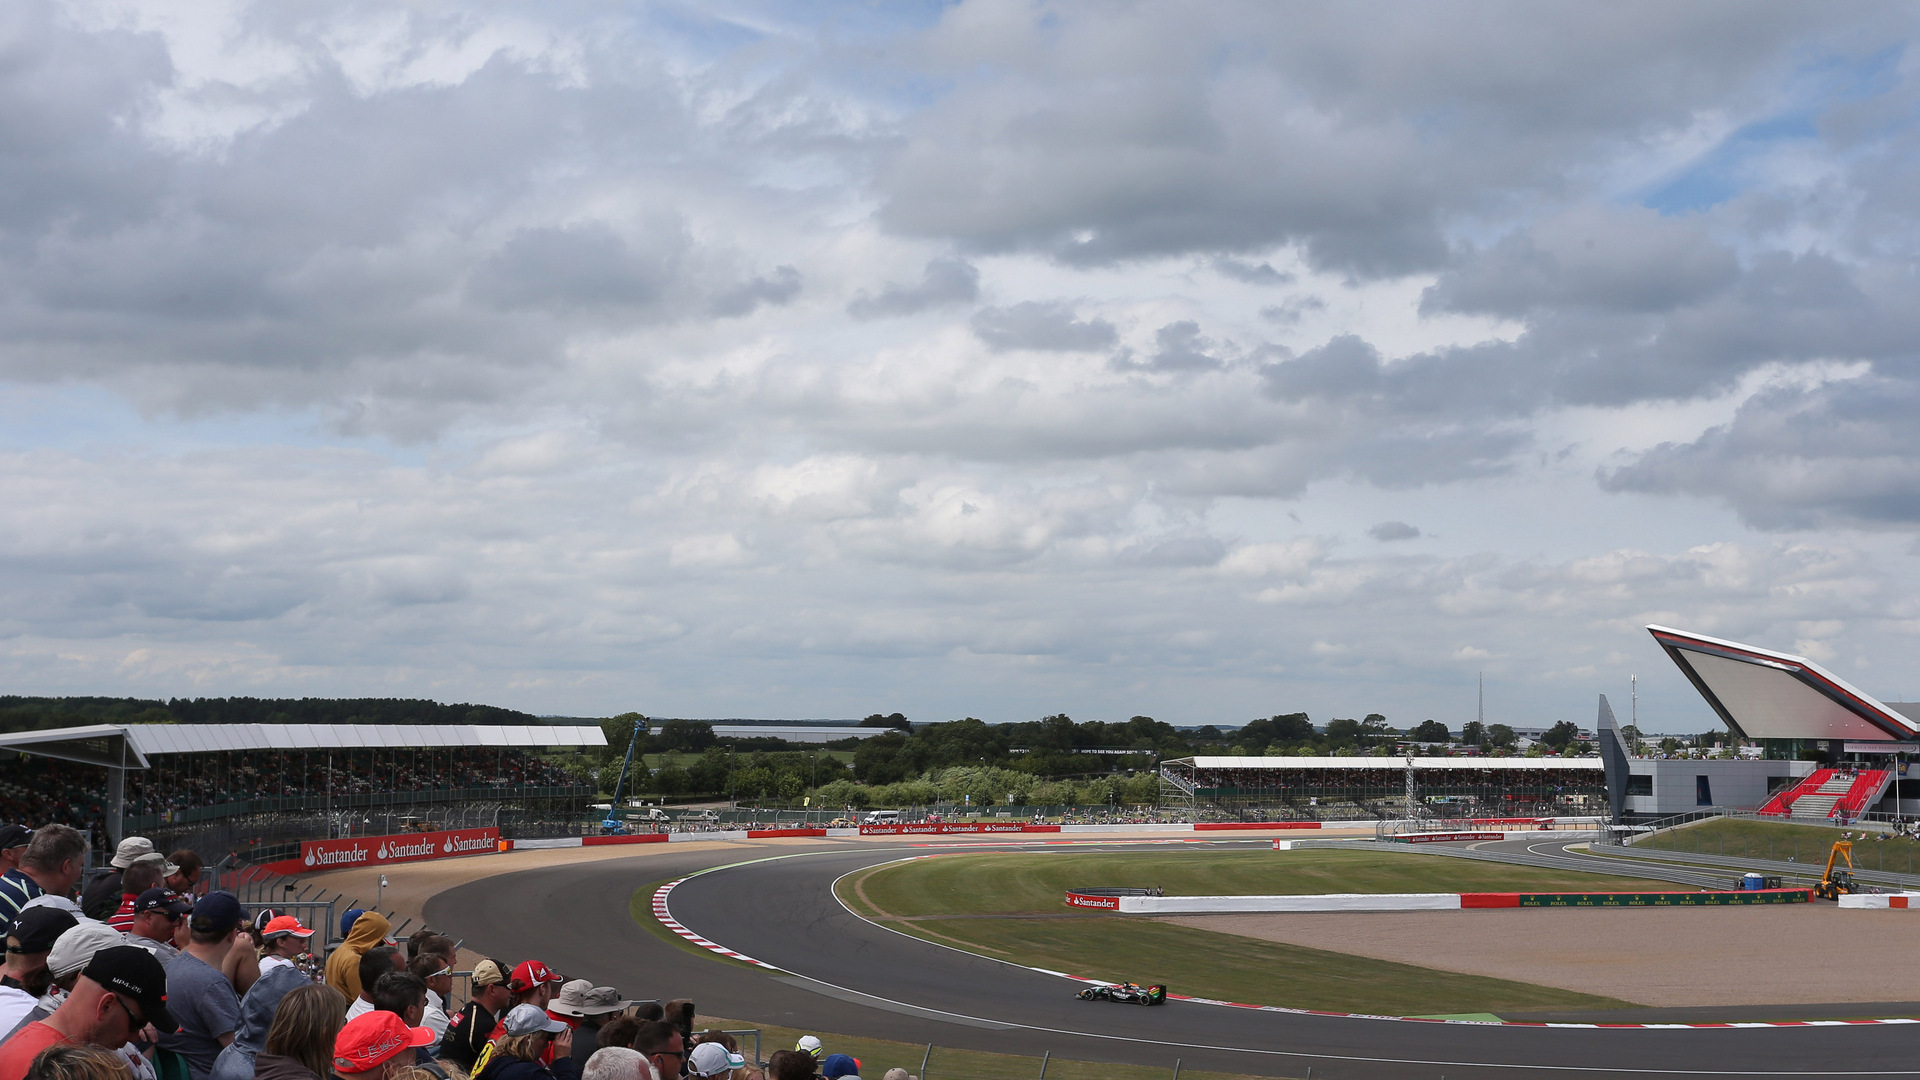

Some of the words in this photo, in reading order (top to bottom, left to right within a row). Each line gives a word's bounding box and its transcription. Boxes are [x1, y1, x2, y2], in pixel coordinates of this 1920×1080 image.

[869, 826, 897, 834] Santander
[908, 825, 937, 833] Santander
[992, 824, 1022, 832] Santander
[388, 837, 435, 858] Santander
[452, 832, 495, 852] Santander
[317, 843, 368, 865] Santander
[1079, 897, 1115, 908] Santander
[112, 976, 143, 994] MP4-26
